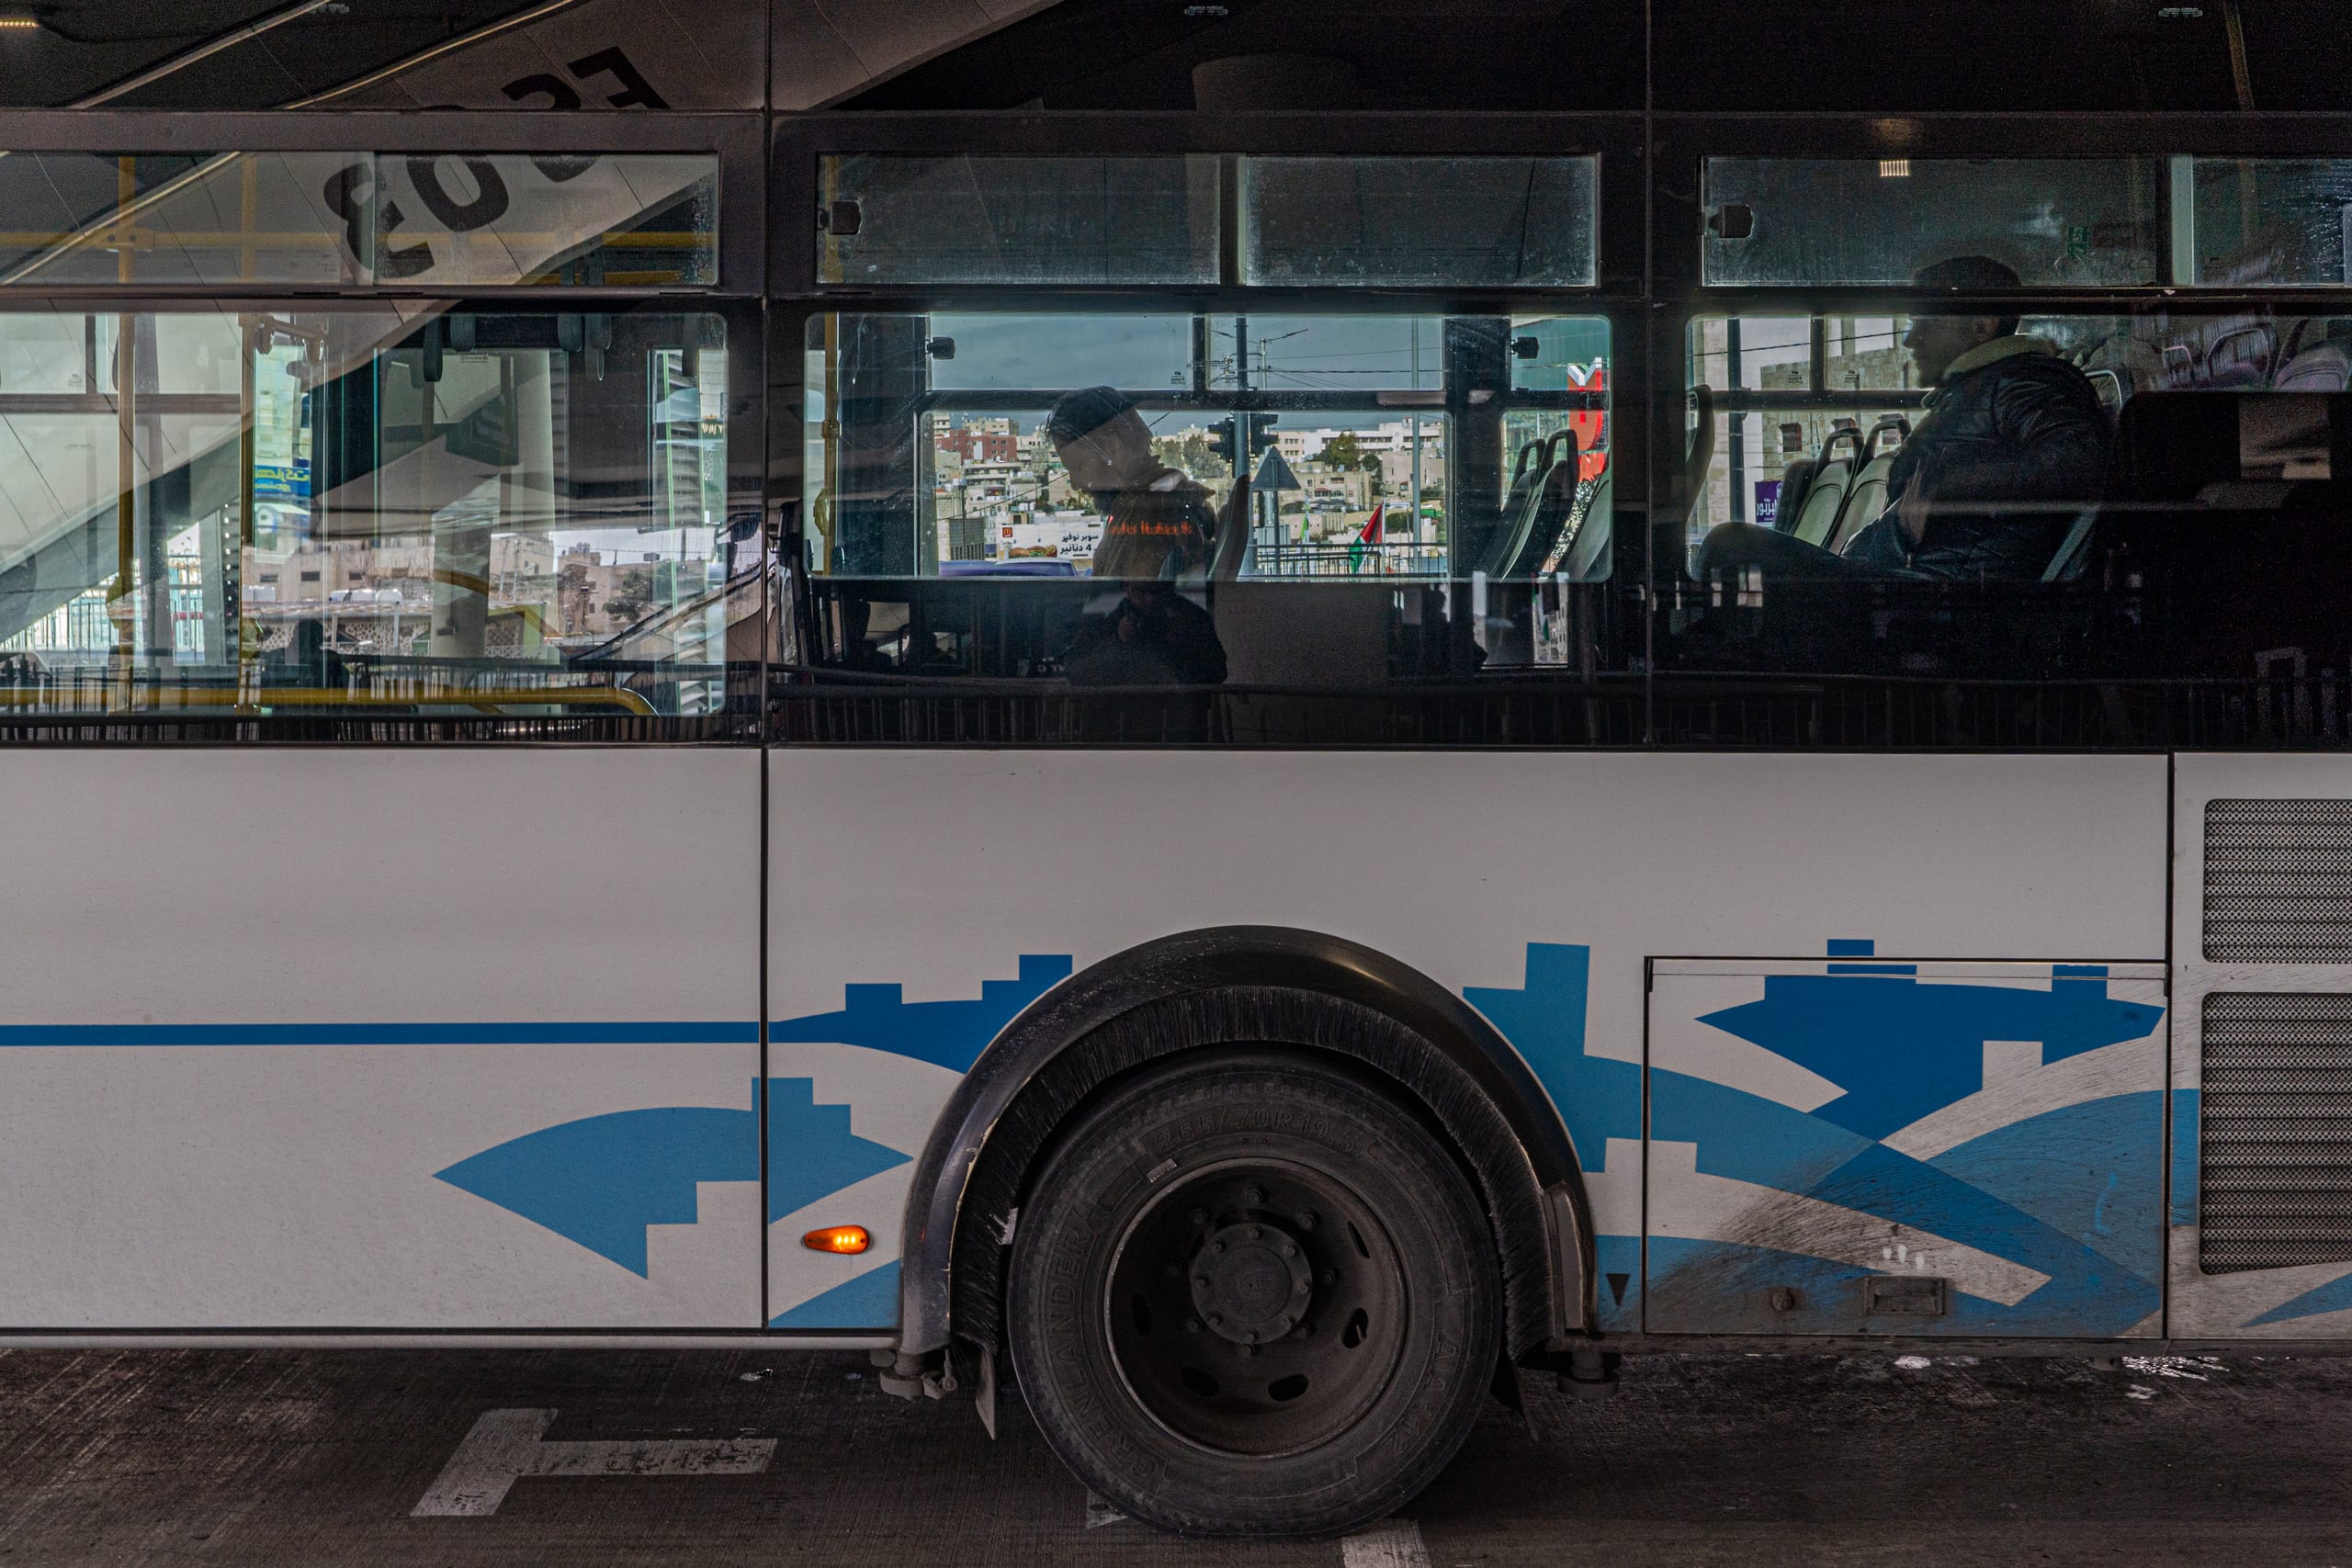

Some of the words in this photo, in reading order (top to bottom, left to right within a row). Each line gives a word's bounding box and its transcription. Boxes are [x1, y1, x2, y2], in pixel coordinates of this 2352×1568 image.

[1061, 532, 1080, 543] توفير
[1059, 543, 1083, 555] دنانير
[1085, 543, 1091, 551] 4
[1155, 1107, 1359, 1153] 265/70R19.5
[1049, 1228, 1161, 1478] GRENLANDER
